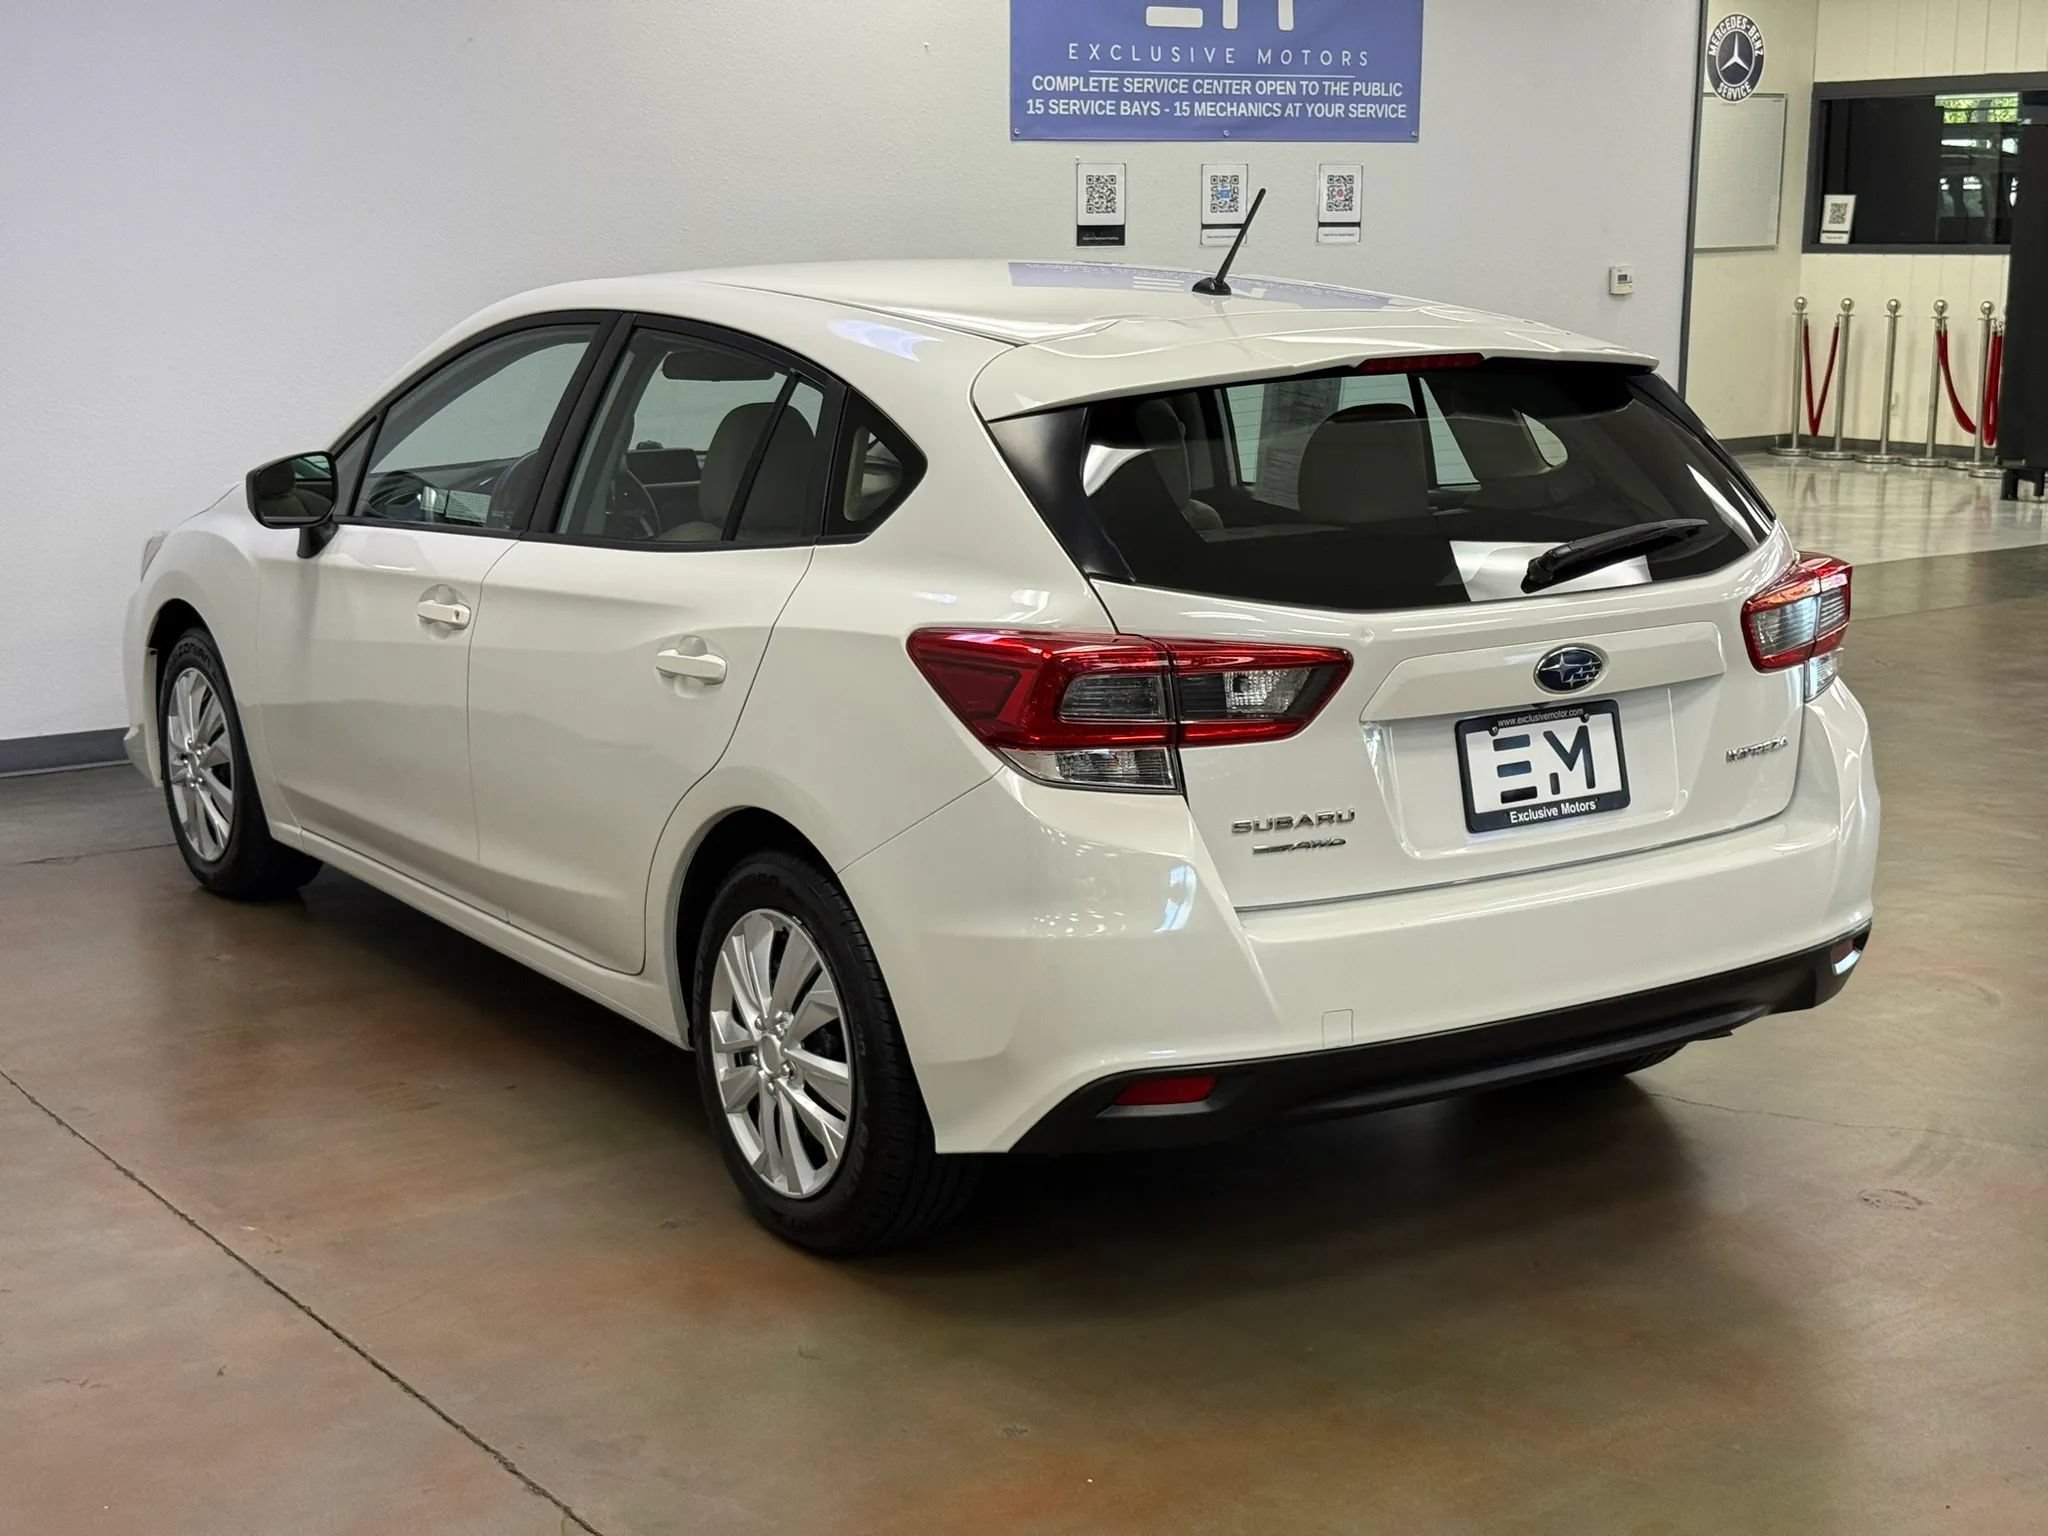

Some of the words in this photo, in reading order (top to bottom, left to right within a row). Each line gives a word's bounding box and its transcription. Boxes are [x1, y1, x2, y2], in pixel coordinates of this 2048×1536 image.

[1708, 15, 1763, 56] MERCEDES-BENZ
[1068, 43, 1235, 64] EXCLUSIVE
[1257, 49, 1368, 66] MOTORS
[1032, 75, 1119, 93] COMPLETE
[1123, 77, 1189, 94] SERVICE
[1192, 79, 1251, 95] CENTER
[1255, 80, 1297, 96] OPEN
[1300, 81, 1319, 96] TO
[1322, 81, 1349, 97] THE
[1353, 82, 1403, 97] PUBLIC
[1717, 81, 1752, 100] SERVICE
[1026, 99, 1044, 115] 15
[1048, 99, 1116, 116] SERVICE
[1120, 100, 1161, 116] BAYS
[1173, 101, 1190, 117] 15
[1194, 102, 1282, 117] MECHANICS
[1284, 103, 1303, 117] AT
[1305, 103, 1345, 118] YOUR
[1349, 104, 1407, 118] SERVICE
[1497, 707, 1584, 727] www.exclusivemotor.com
[1231, 809, 1355, 833] SUBARU
[1510, 807, 1559, 824] Exclusive
[1561, 800, 1597, 815] Motors
